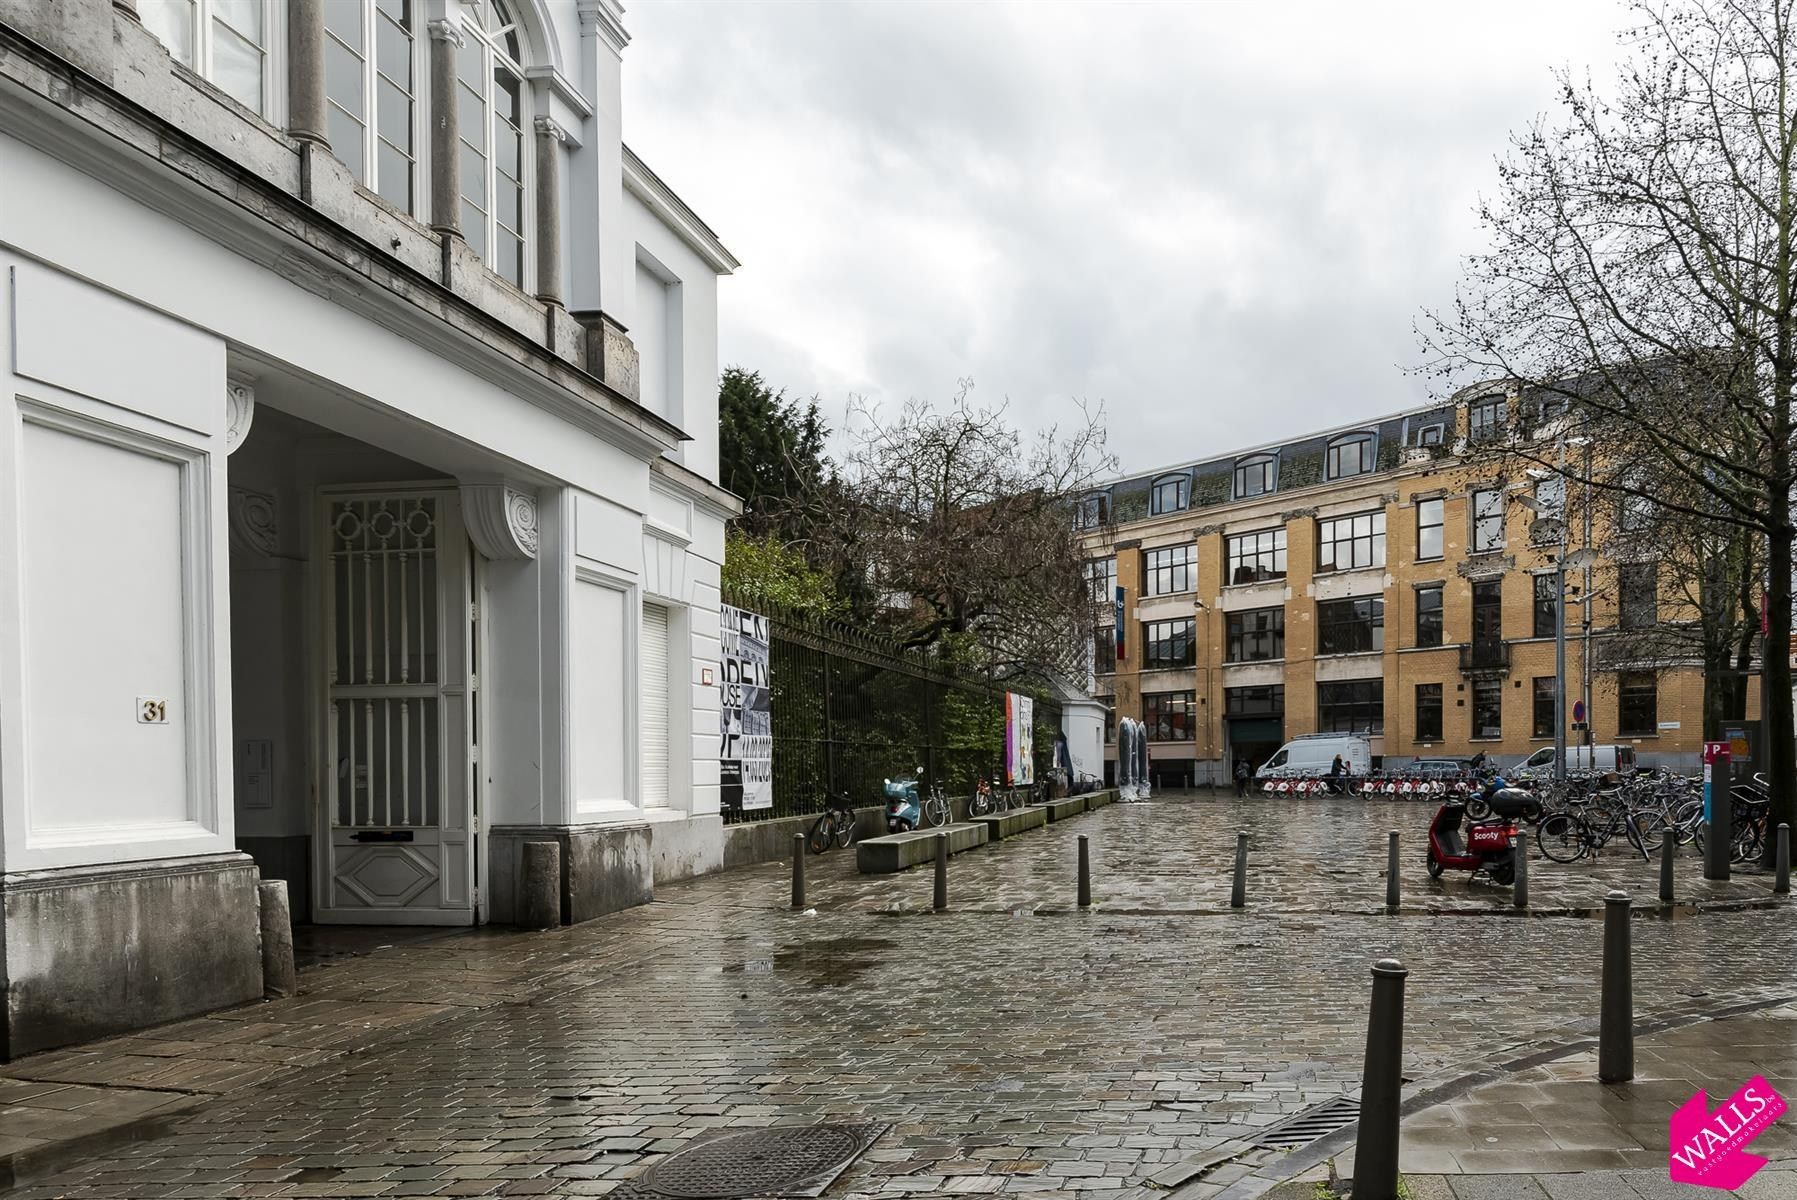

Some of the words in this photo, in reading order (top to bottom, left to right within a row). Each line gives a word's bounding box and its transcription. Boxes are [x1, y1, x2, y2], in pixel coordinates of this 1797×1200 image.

[144, 700, 166, 721] 31
[1712, 744, 1721, 755] P
[1474, 831, 1499, 841] Scooty
